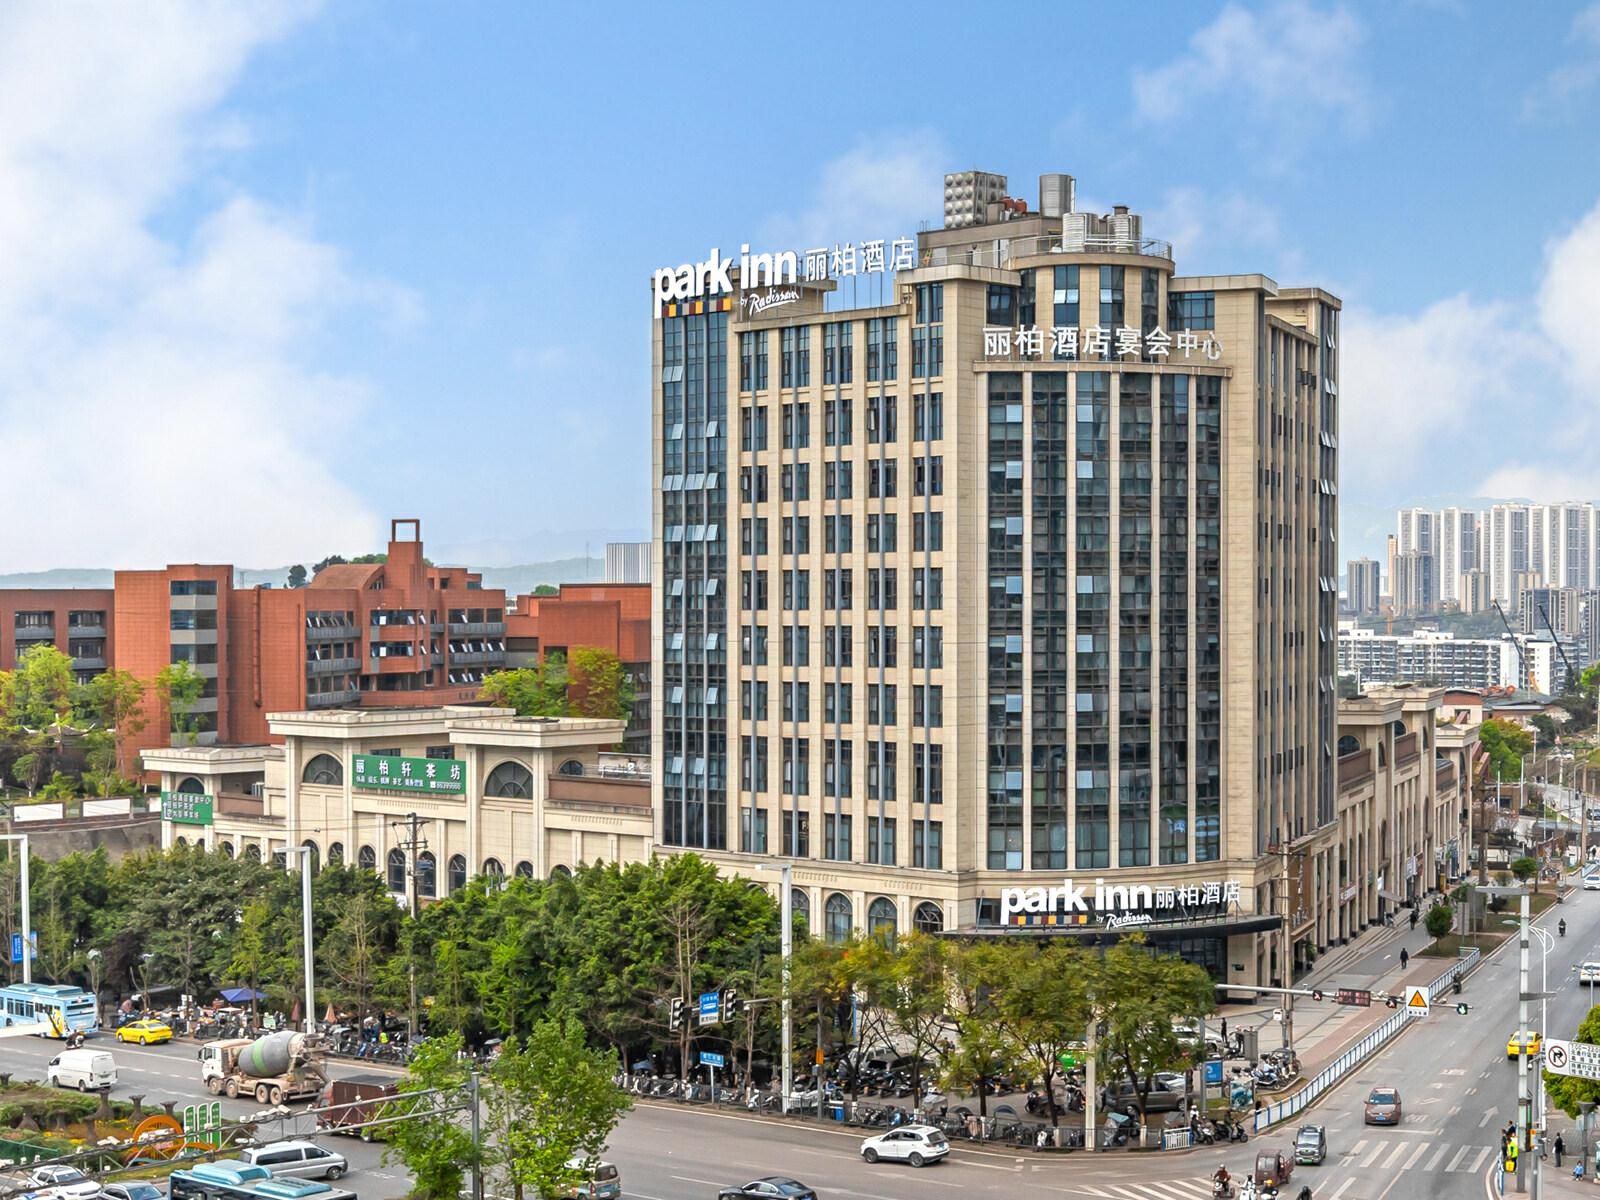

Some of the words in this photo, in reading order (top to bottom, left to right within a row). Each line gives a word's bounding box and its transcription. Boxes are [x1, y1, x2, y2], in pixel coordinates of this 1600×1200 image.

[654, 248, 733, 319] park
[740, 243, 797, 290] inn
[805, 239, 914, 282] 丽柏酒店
[749, 288, 799, 316] Radisson
[982, 324, 1224, 361] 丽柏酒店宴会中心
[356, 759, 461, 781] 丽柏轩茶坊
[1000, 878, 1089, 926] park
[1095, 878, 1152, 911] inn
[1156, 879, 1241, 909] 丽柏酒店
[1105, 911, 1153, 930] Radisson
